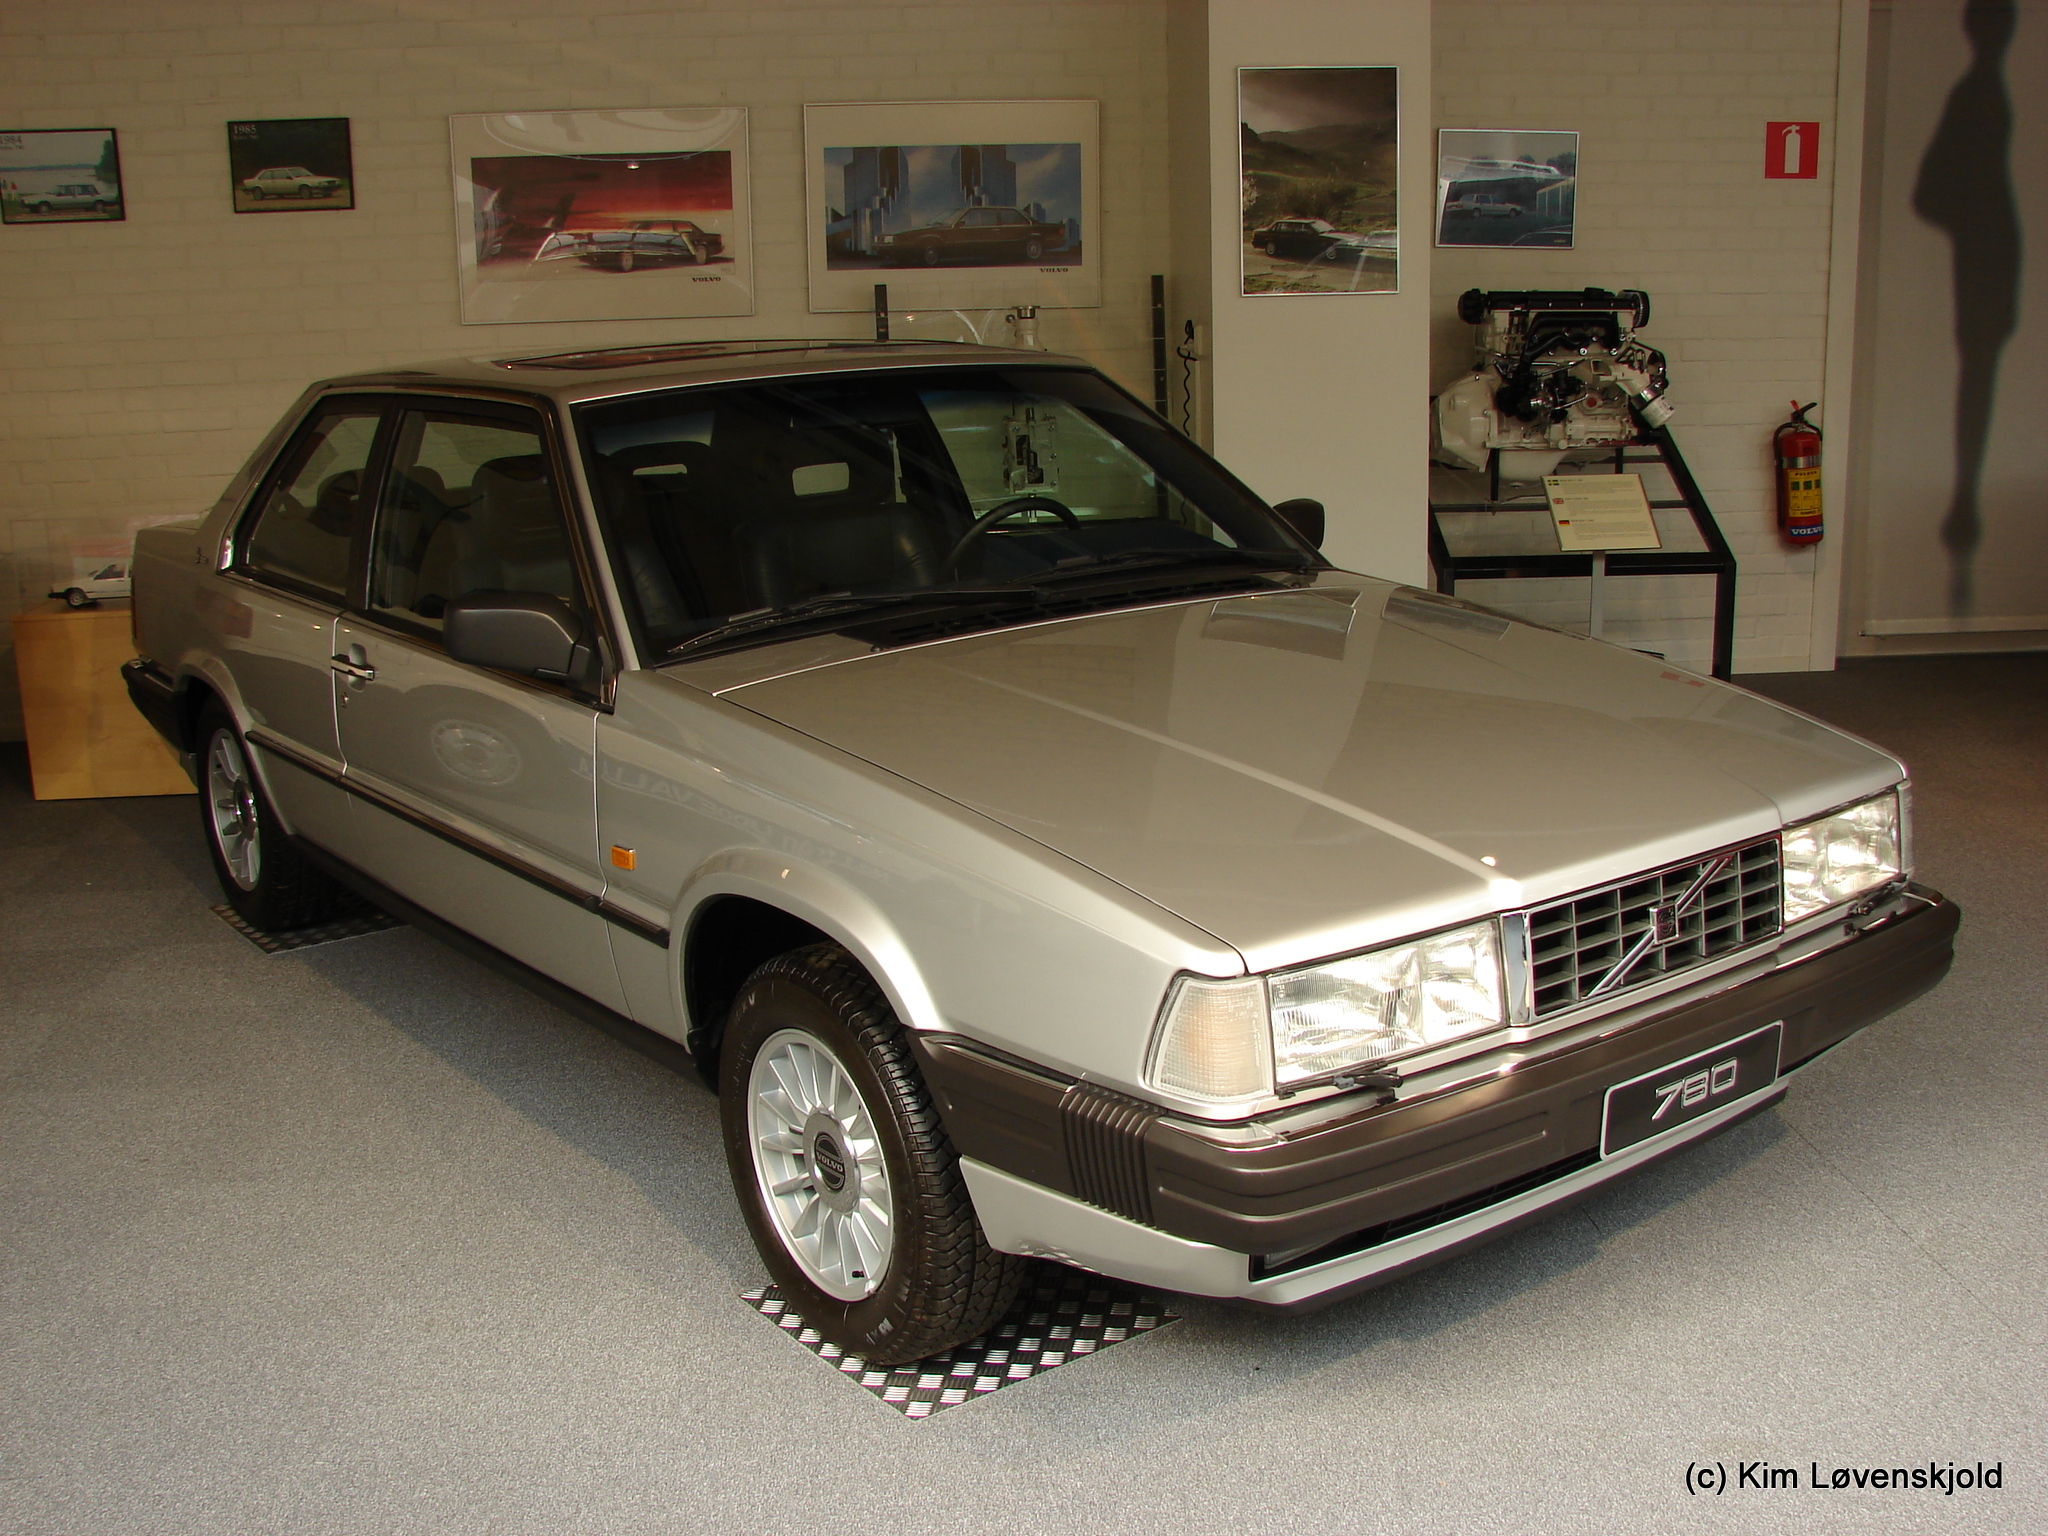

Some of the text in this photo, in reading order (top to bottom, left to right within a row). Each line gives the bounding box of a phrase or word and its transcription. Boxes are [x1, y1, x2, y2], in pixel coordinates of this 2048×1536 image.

[234, 124, 256, 134] 1985
[1652, 1057, 1737, 1121] 780
[816, 1152, 843, 1172] VOLVO
